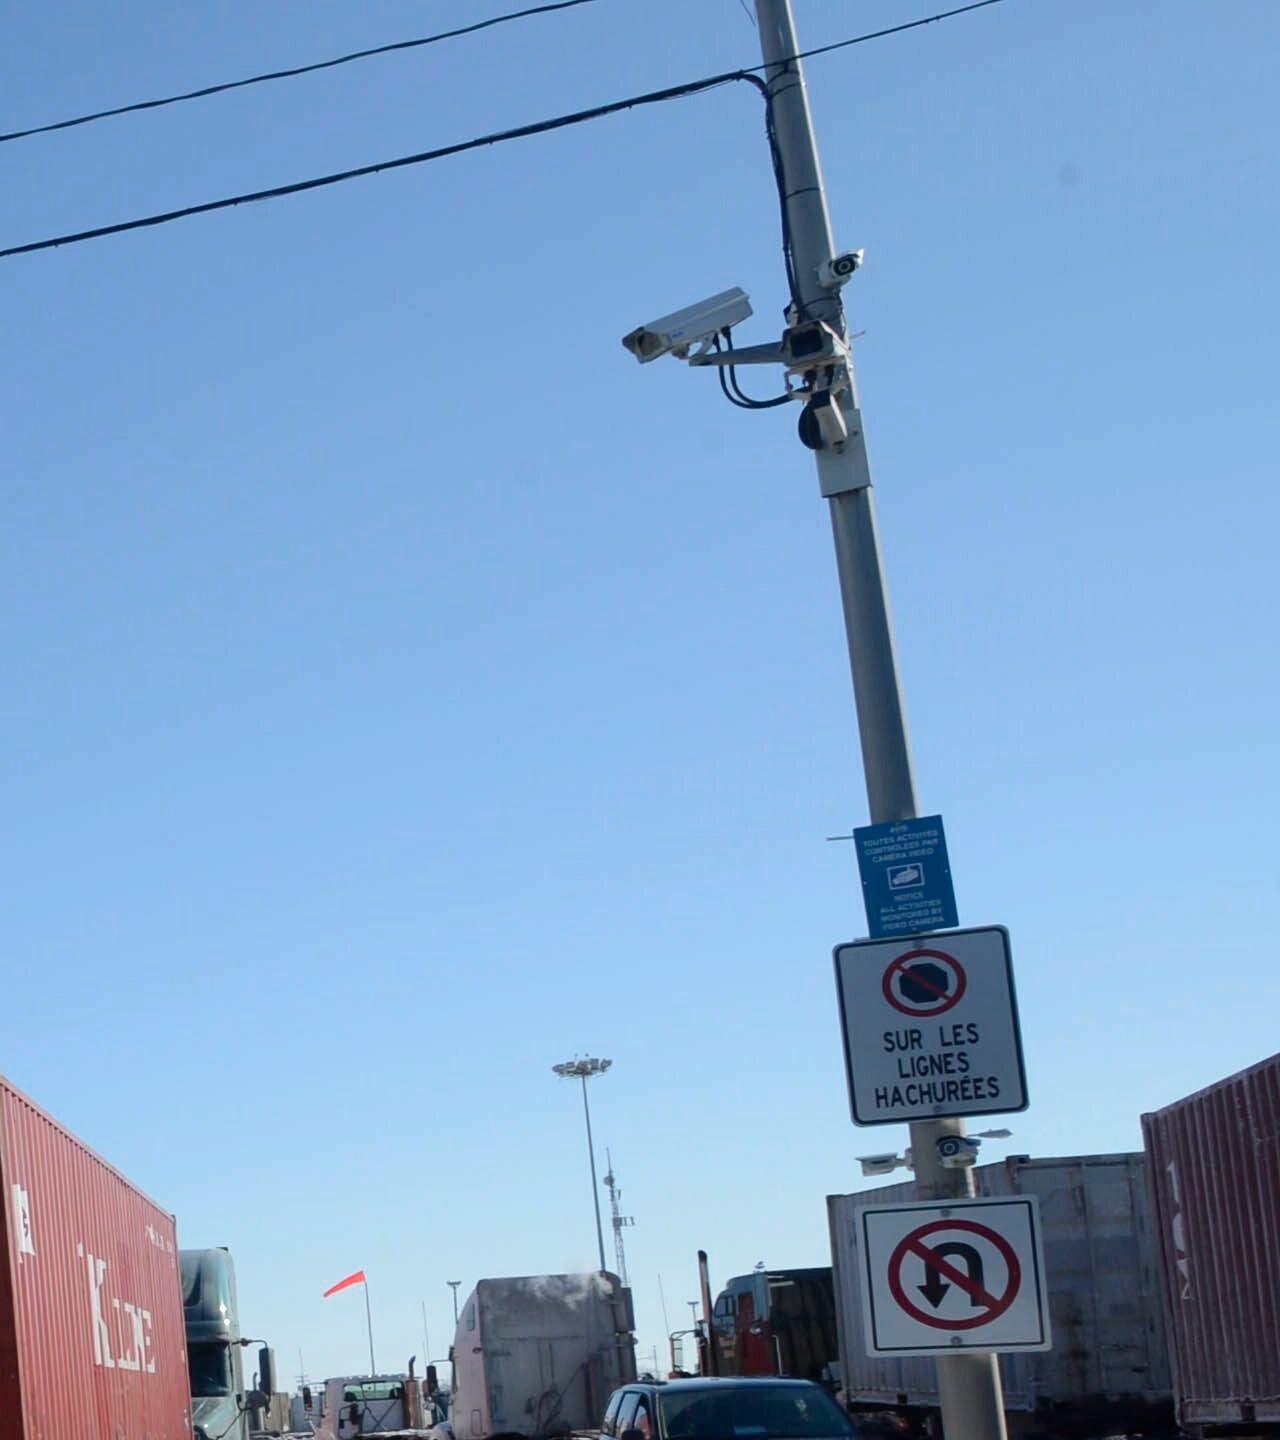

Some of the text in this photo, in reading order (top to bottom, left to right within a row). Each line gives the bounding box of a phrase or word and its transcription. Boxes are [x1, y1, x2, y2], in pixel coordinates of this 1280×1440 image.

[883, 1022, 980, 1053] SUR LES
[897, 1051, 970, 1079] LIGNES
[874, 1075, 1001, 1109] HACHURÉES
